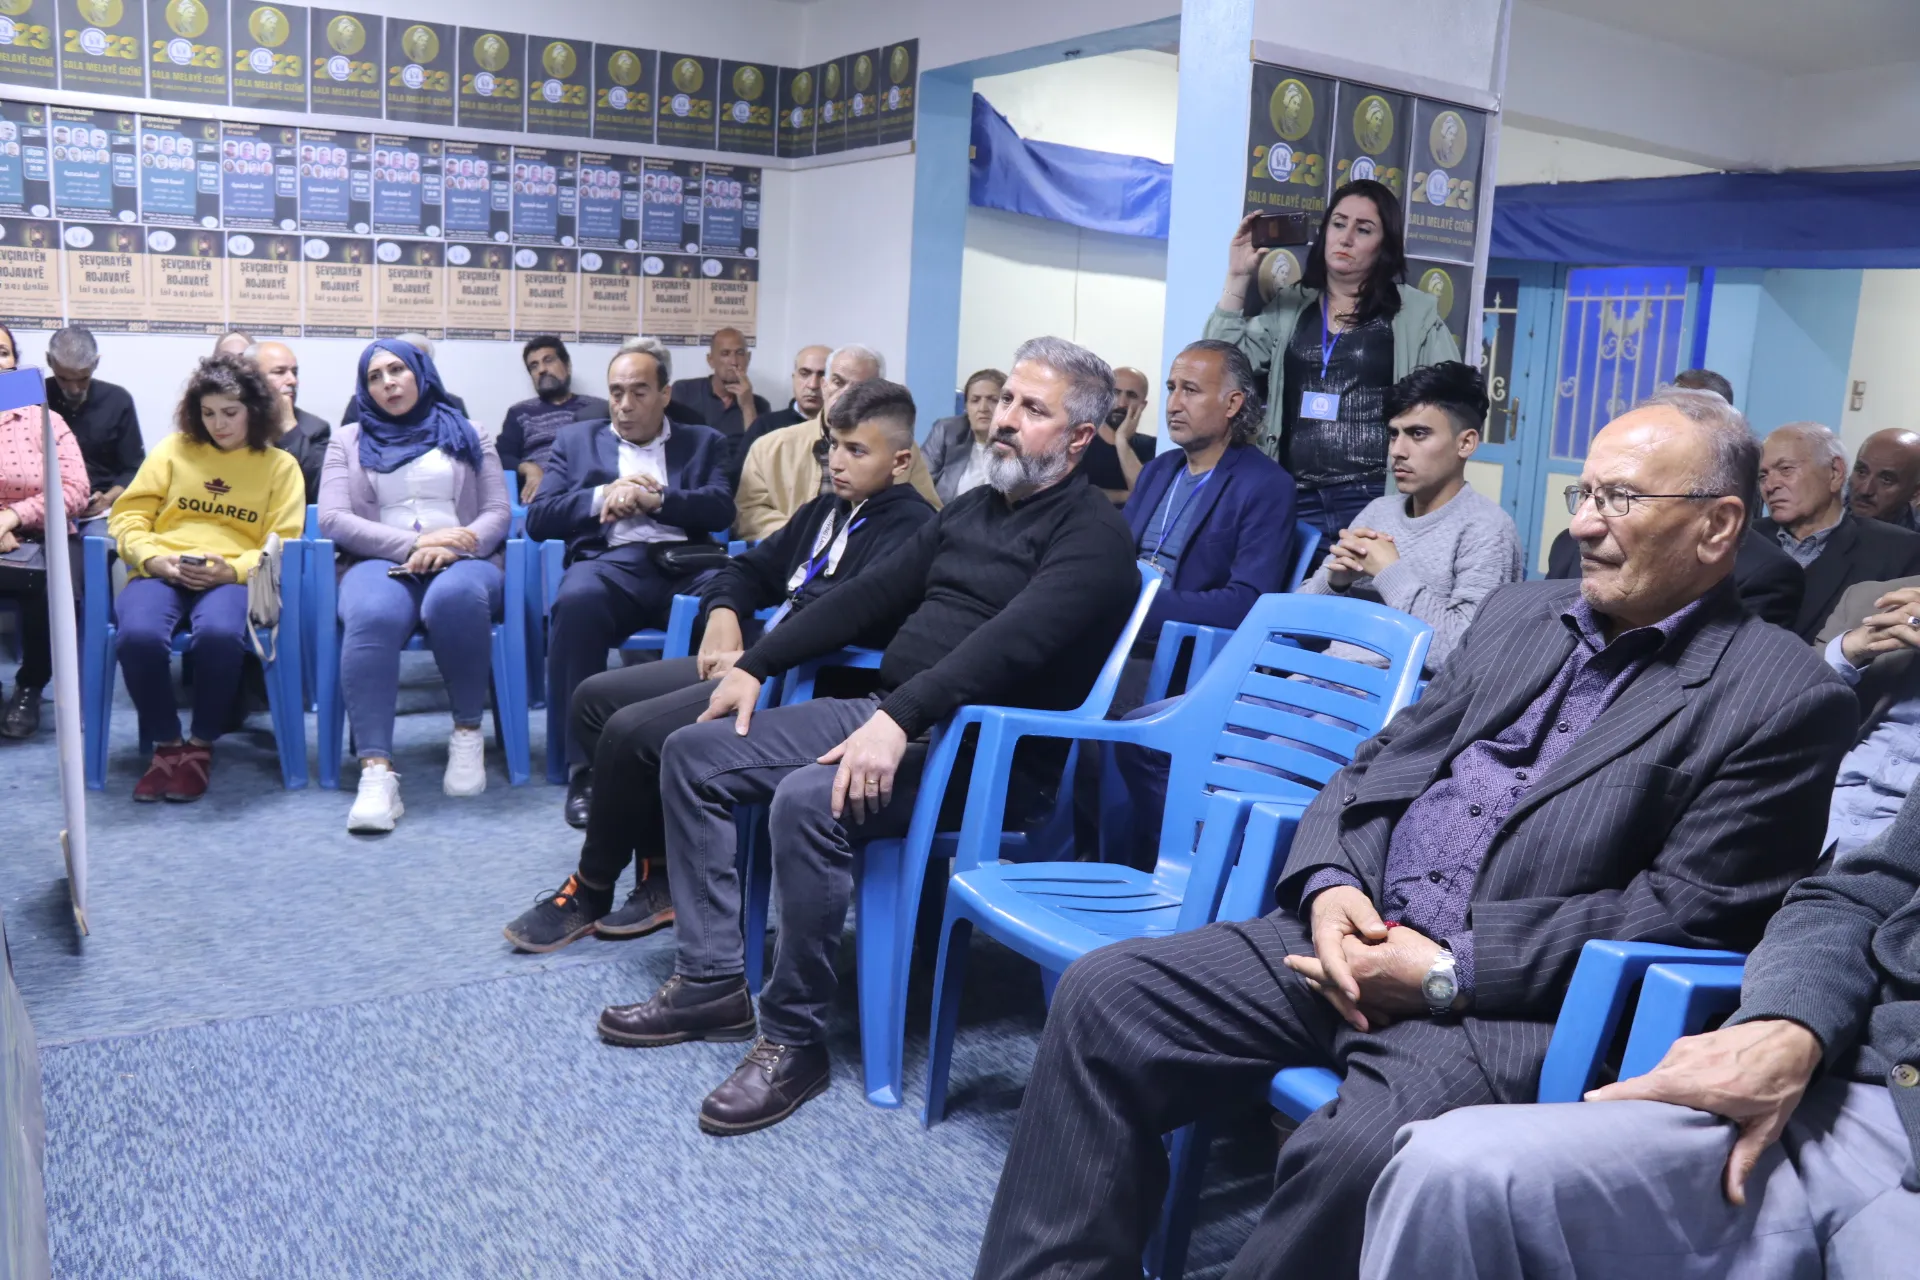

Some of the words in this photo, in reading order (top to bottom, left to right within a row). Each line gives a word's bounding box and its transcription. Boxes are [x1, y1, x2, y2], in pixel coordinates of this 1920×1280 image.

[1248, 190, 1266, 204] SALA
[1269, 193, 1300, 208] MELAYÊ
[79, 252, 132, 269] ŞEVÇIRAYÊN
[161, 256, 212, 272] ŞEVÇIRAYÊN
[240, 260, 288, 276] ŞEVÇIRAYÊN
[85, 270, 131, 283] ROJAVAYÊ
[166, 273, 209, 286] ROJAVAYÊ
[245, 277, 286, 289] ROJAVAYÊ
[178, 497, 258, 523] SQUARED
